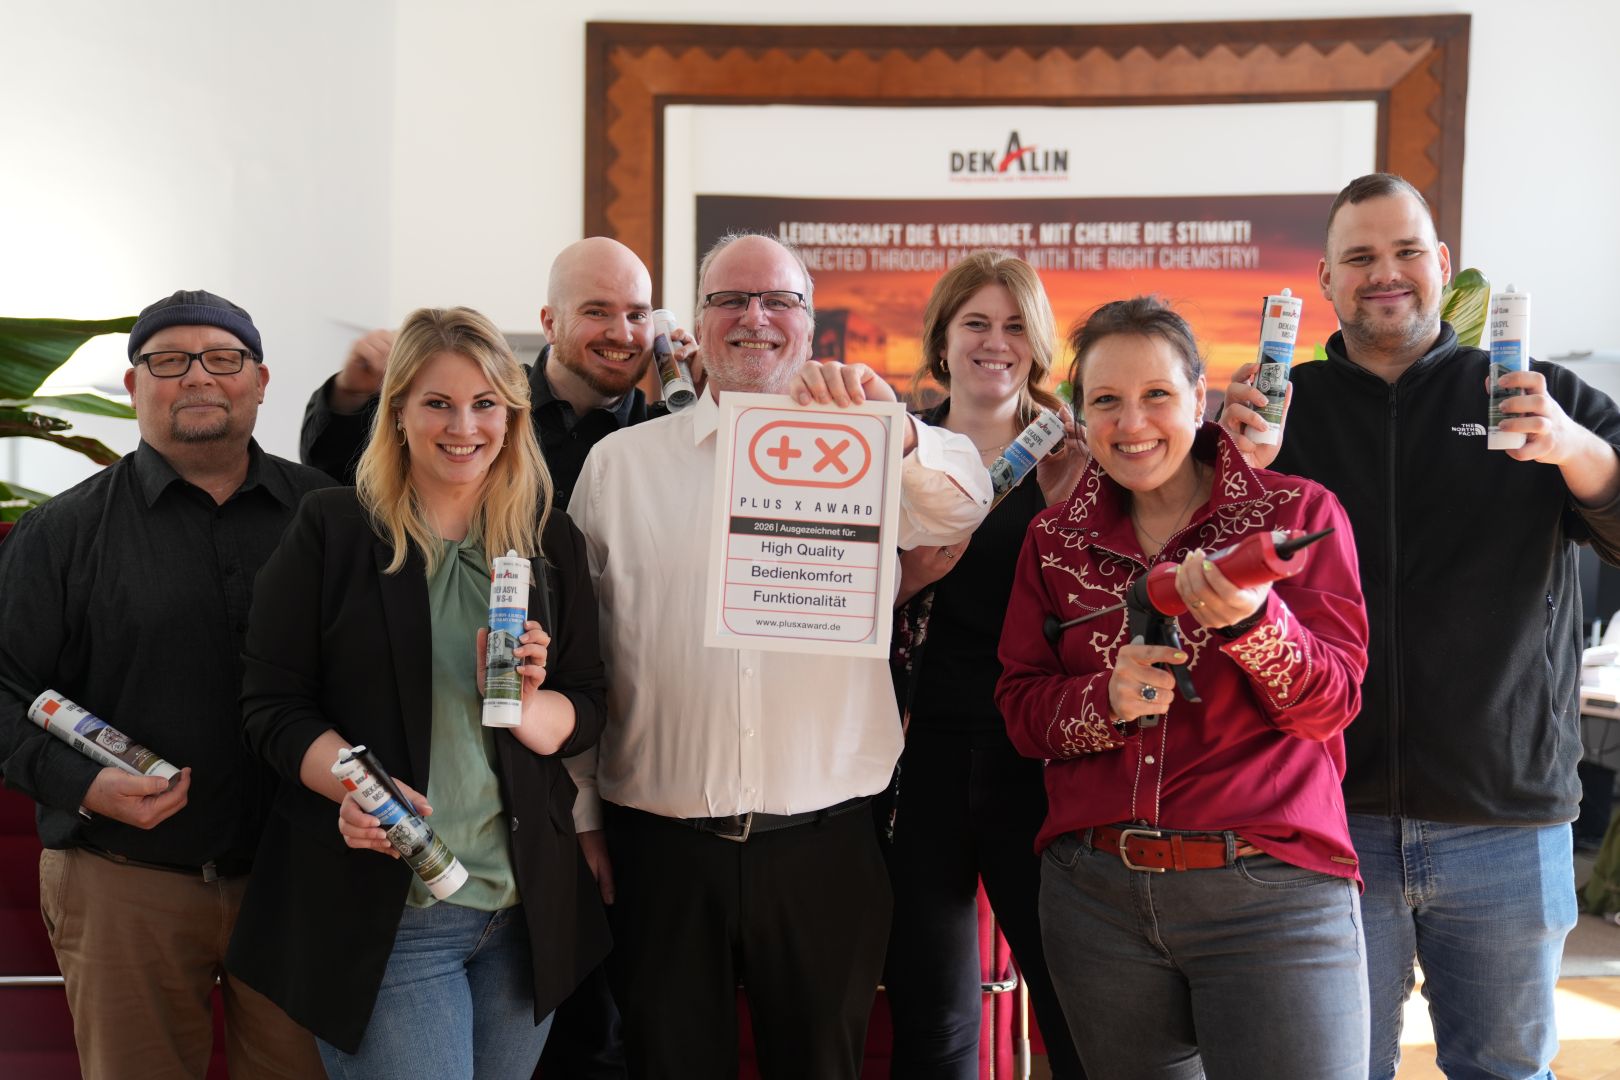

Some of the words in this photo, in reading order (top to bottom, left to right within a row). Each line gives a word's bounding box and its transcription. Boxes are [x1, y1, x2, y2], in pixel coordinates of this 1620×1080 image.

[951, 130, 1068, 173] DEKALIN
[779, 222, 902, 246] LEIDENSCHAFT
[905, 223, 935, 246] DIE
[937, 223, 1037, 247] VERBINDET,
[1039, 223, 1072, 245] MIT
[1074, 222, 1141, 245] CHEMIE
[1143, 222, 1174, 244] DIE
[1176, 220, 1252, 244] STIMMT!
[797, 247, 867, 271] NECTED
[871, 248, 945, 271] THROUGH
[1024, 248, 1069, 270] WITH
[1072, 247, 1103, 271] THE
[1106, 247, 1155, 270] RIGHT
[1159, 246, 1260, 270] CHEMISTRY!
[740, 496, 782, 510] PLUS
[795, 501, 802, 511] X
[815, 502, 874, 516] AWARD
[754, 522, 774, 532] 2026
[780, 524, 840, 537] Ausgezeichnet
[842, 529, 856, 538] für:
[761, 541, 792, 557] High
[797, 544, 845, 560] Quality
[751, 565, 853, 584] Bedienkomfort
[753, 590, 847, 608] Funktionalität
[755, 619, 841, 632] www.plusxaward.de
